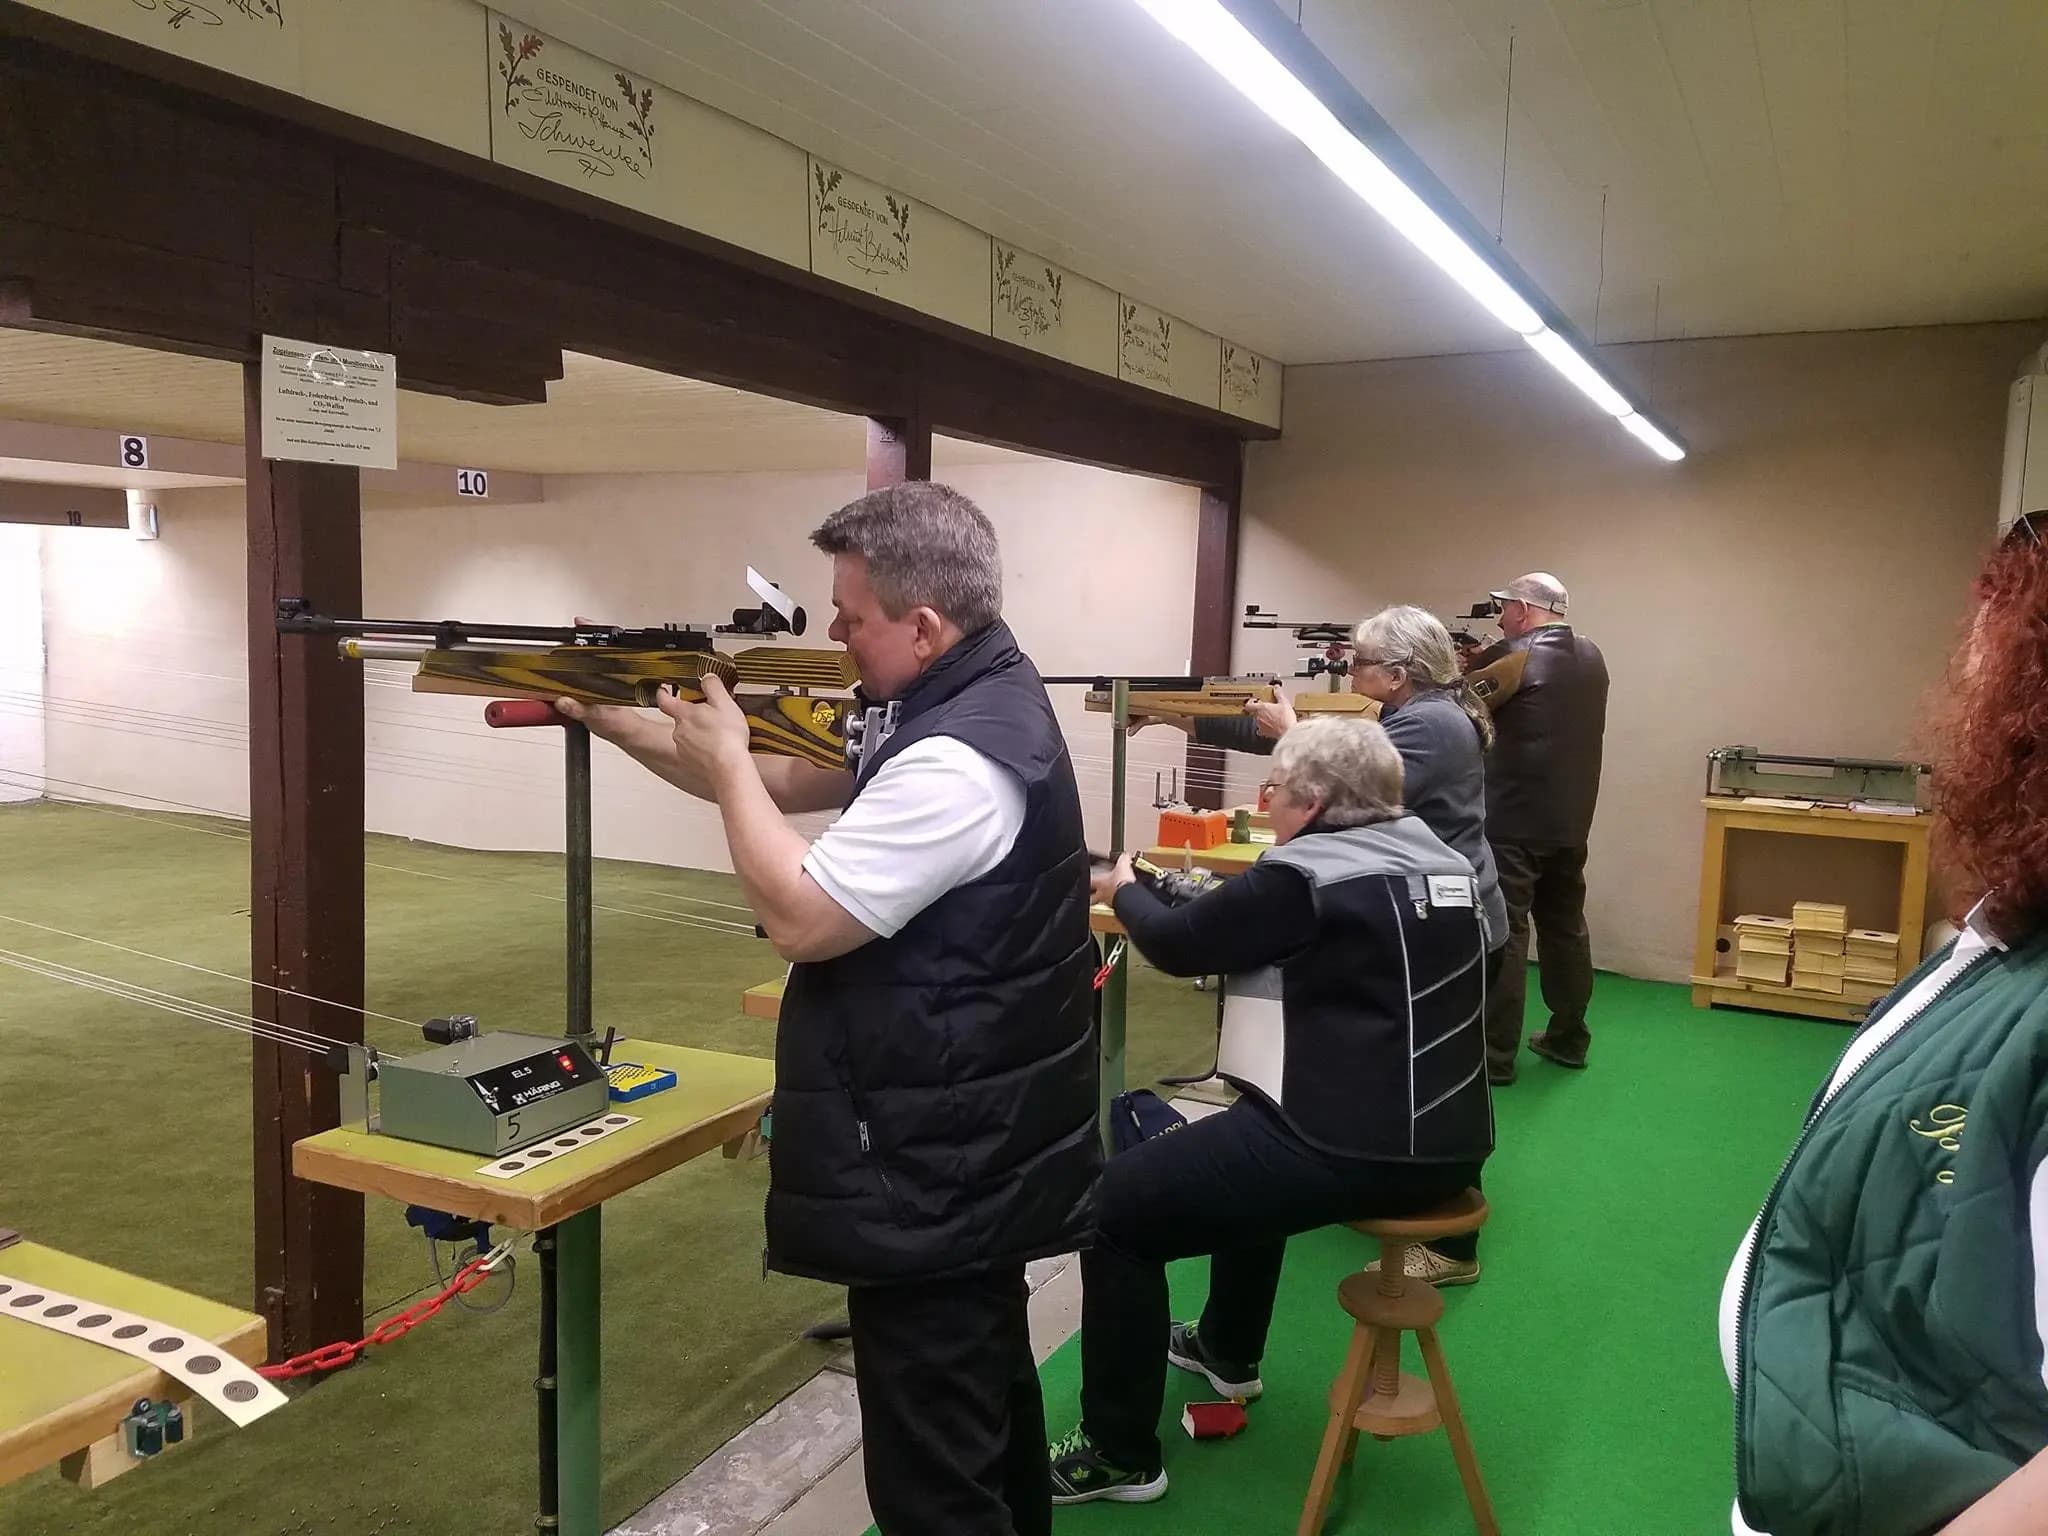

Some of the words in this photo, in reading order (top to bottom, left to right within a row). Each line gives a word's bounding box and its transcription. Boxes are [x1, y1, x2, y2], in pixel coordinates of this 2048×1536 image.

[536, 67, 597, 102] GESPENDET
[598, 93, 619, 112] VON
[124, 437, 145, 467] 8
[459, 471, 486, 496] 10
[66, 510, 82, 526] 10
[507, 1111, 521, 1140] 5
